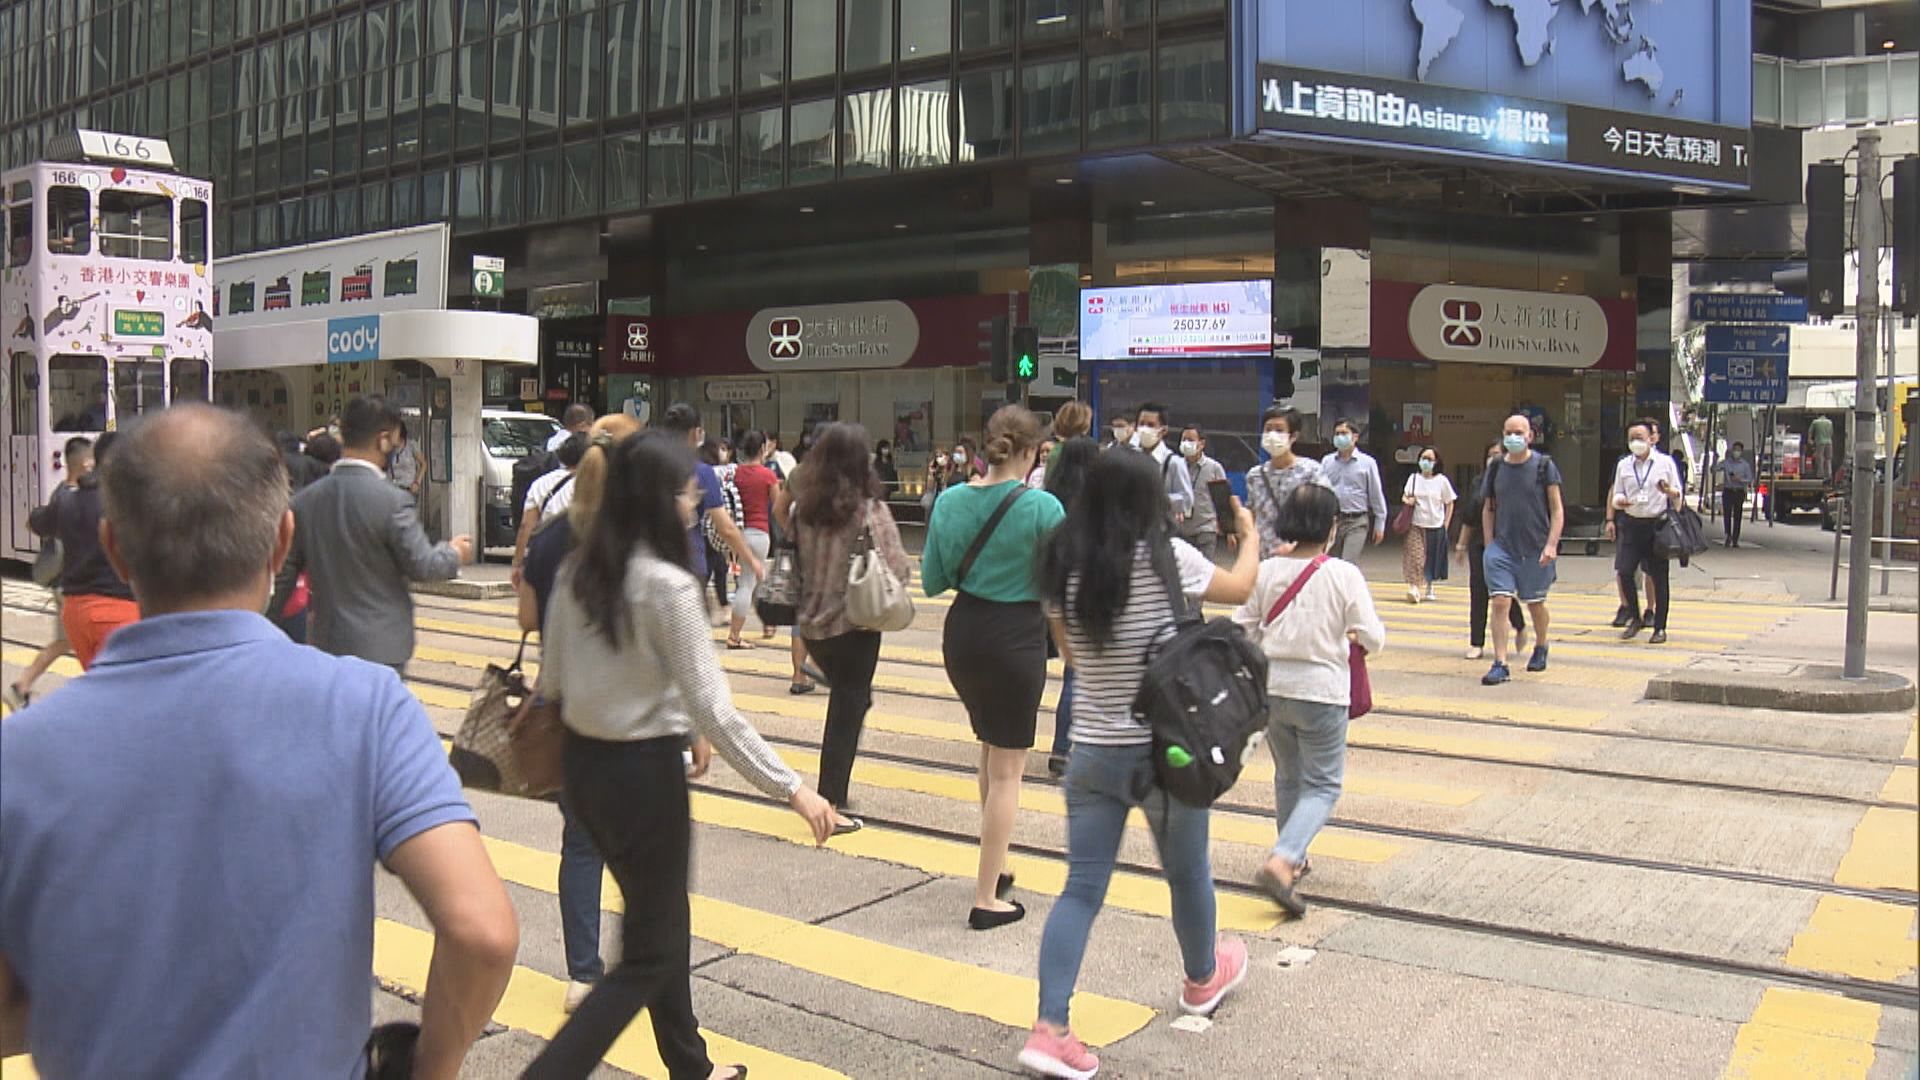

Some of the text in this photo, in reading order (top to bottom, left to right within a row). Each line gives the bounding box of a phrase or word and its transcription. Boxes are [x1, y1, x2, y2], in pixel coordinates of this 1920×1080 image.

[101, 135, 151, 160] 166
[1602, 126, 1722, 167] 今日天氣預測
[52, 171, 76, 184] 166
[193, 186, 209, 200] 166
[80, 266, 190, 289] 香港小交響樂團
[1212, 302, 1230, 314] HSI
[1774, 296, 1804, 305] Station
[1172, 318, 1227, 331] 25037.69
[1492, 302, 1582, 331] 大新銀行
[328, 324, 379, 355] cody
[1548, 338, 1581, 355] BANK
